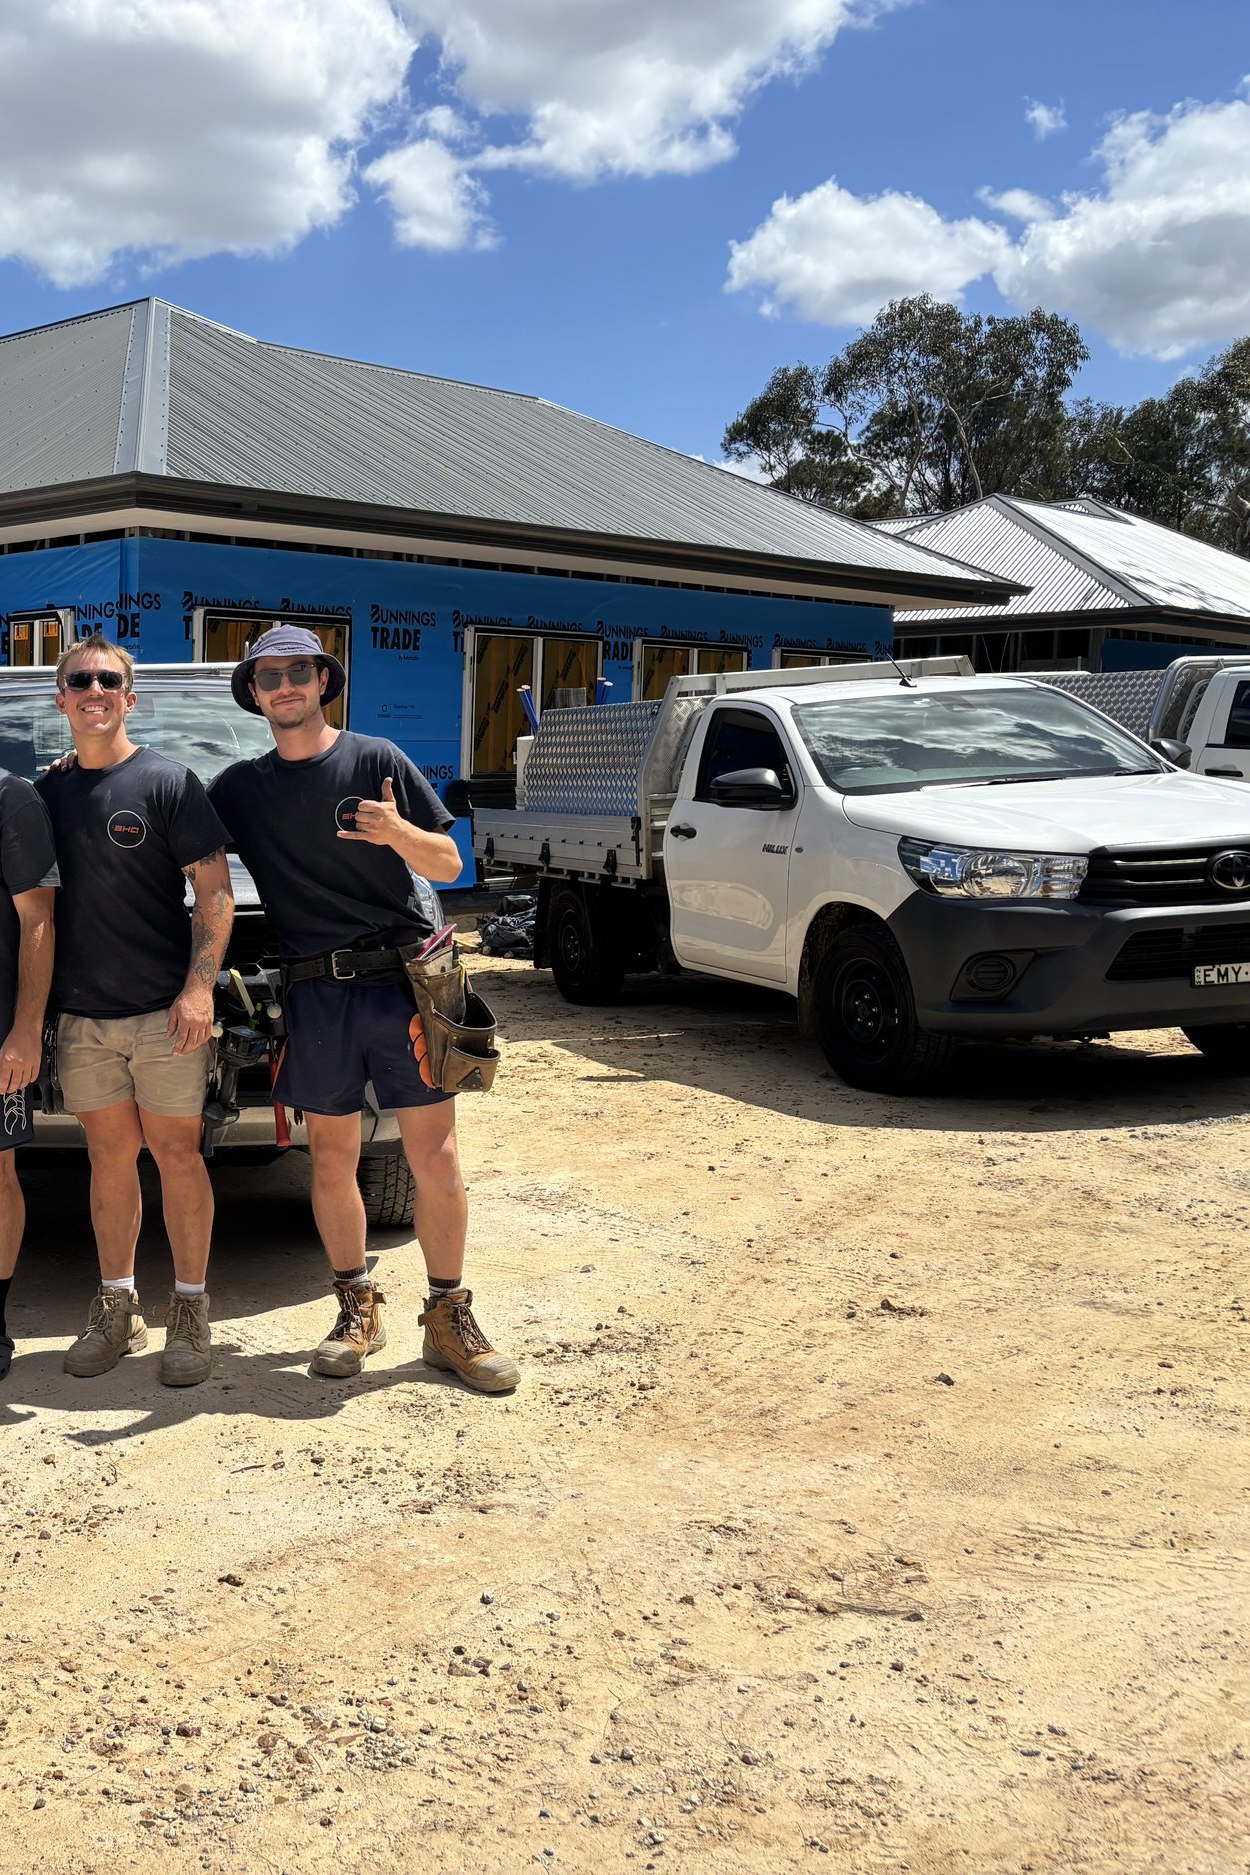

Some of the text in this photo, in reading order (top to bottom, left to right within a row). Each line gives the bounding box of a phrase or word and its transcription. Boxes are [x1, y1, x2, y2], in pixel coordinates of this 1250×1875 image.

[371, 604, 436, 627] BUNNINGS
[371, 626, 421, 651] TRADE
[597, 620, 649, 639] BUNNINGS
[417, 765, 454, 780] NINGS
